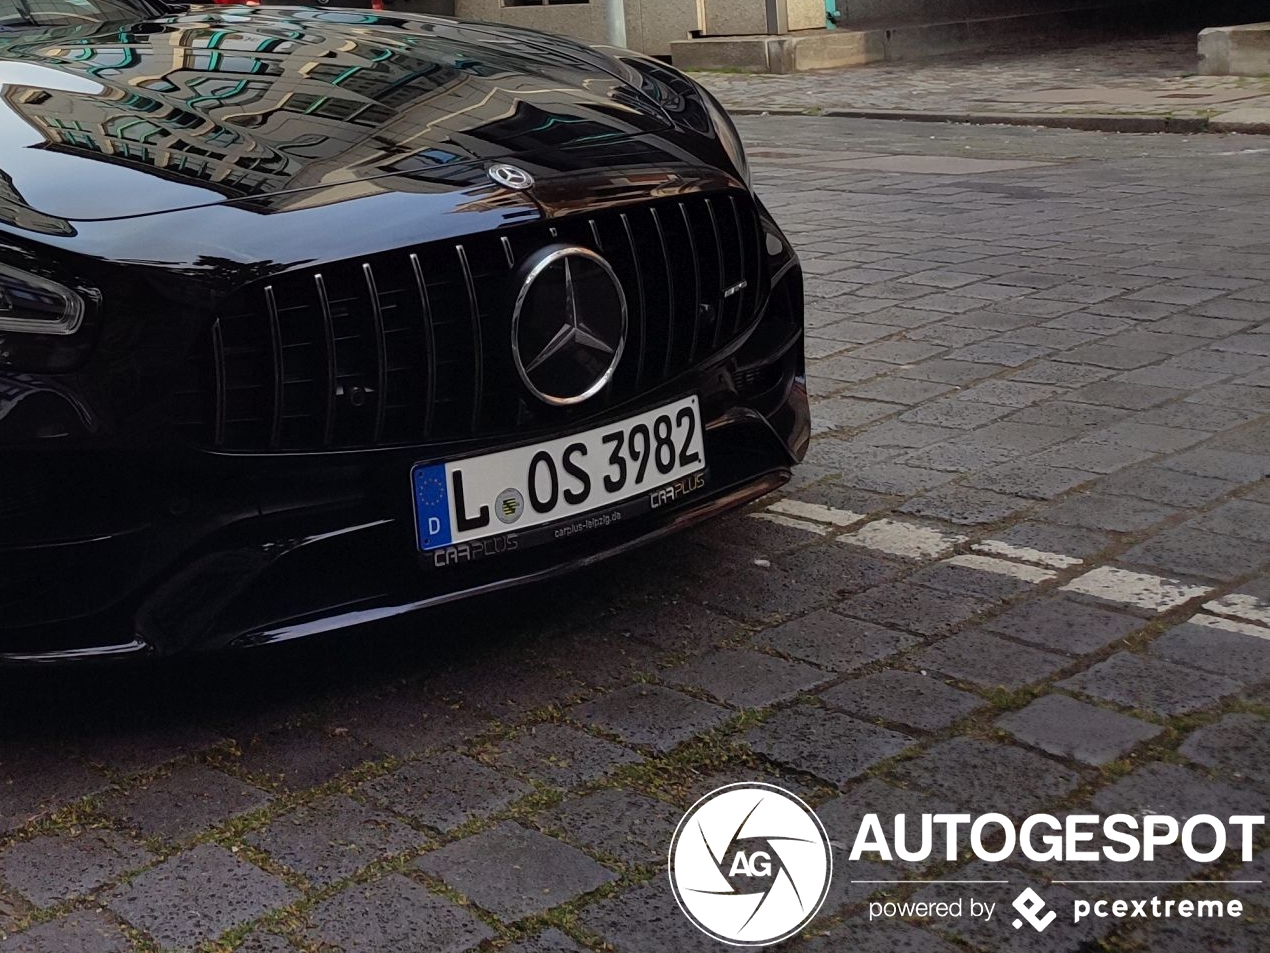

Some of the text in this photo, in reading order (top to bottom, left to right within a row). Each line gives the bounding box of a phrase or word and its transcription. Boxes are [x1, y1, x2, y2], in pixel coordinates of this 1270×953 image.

[451, 406, 701, 532] L OS 3982
[650, 473, 706, 509] CARPLUS
[428, 516, 440, 535] D
[434, 533, 519, 568] CARPLUS
